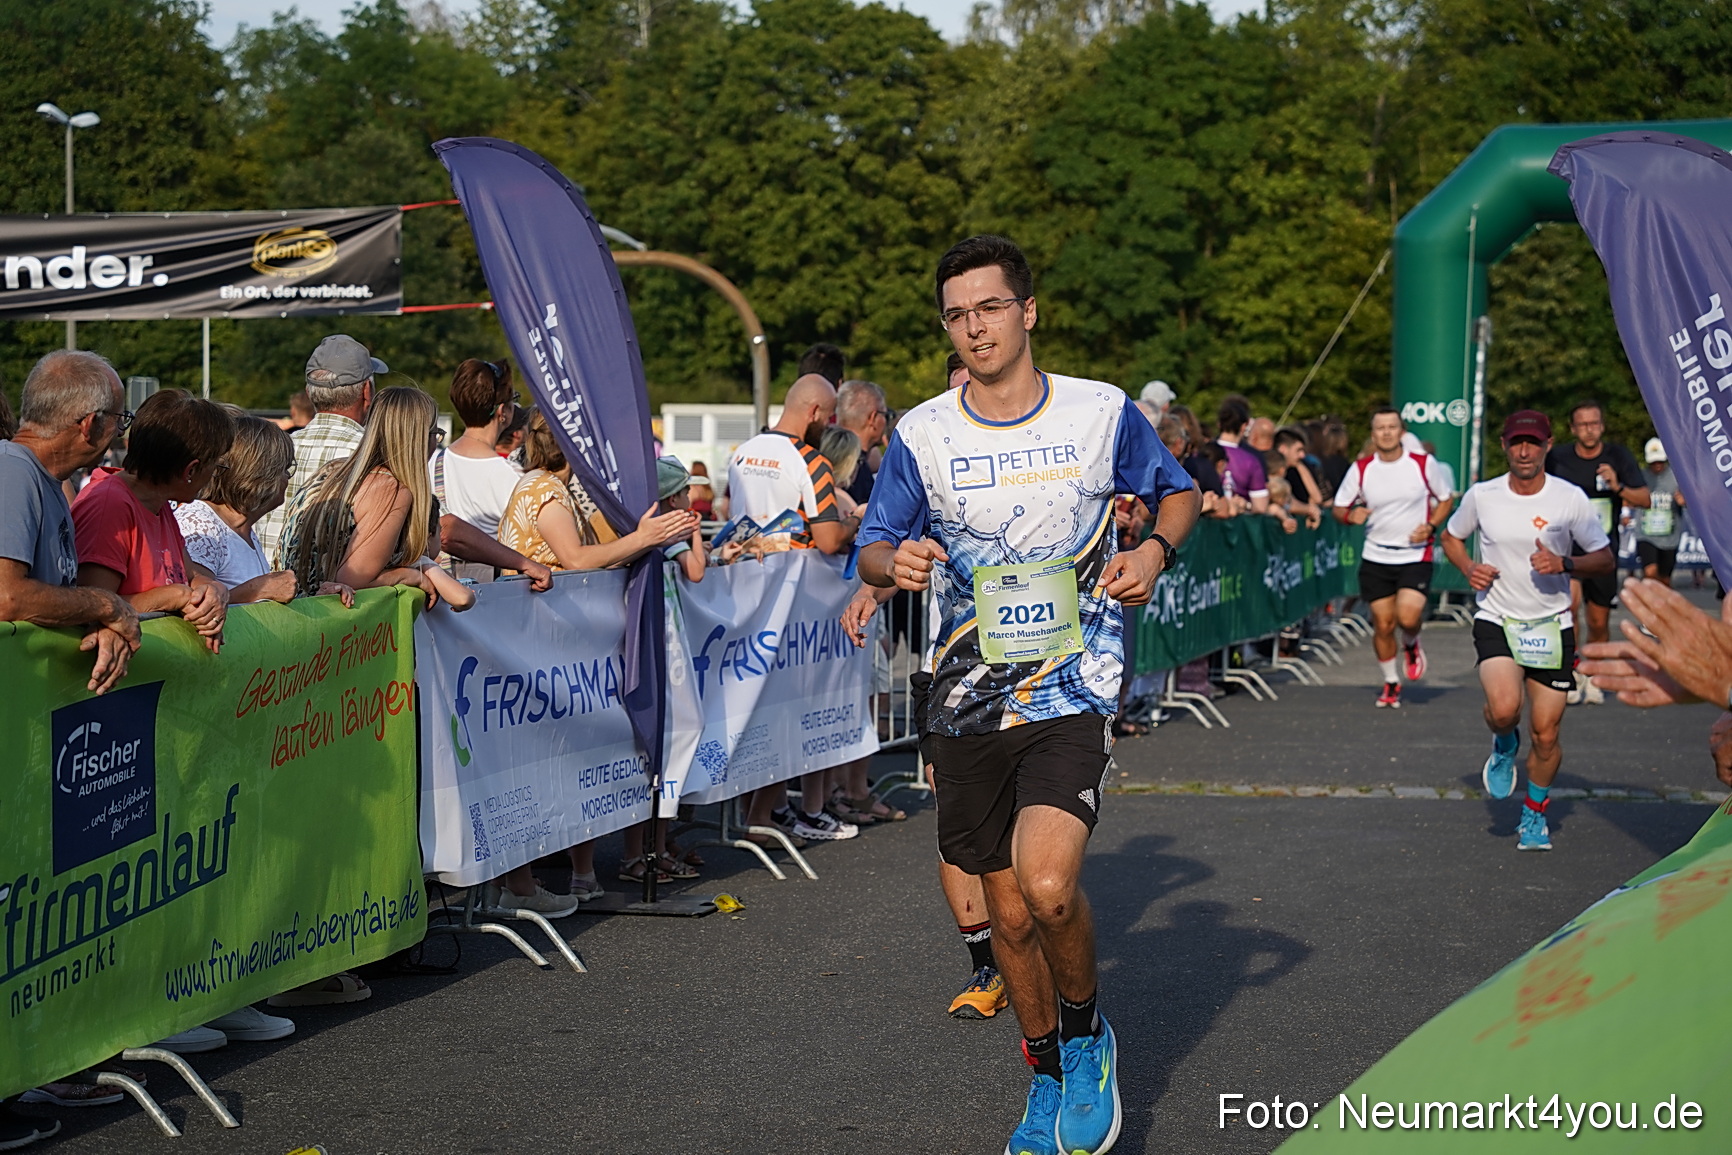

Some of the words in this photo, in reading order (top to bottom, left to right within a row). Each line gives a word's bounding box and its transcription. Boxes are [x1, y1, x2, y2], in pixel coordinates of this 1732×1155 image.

[220, 285, 243, 299] Ein
[244, 285, 271, 300] Ort,
[273, 285, 299, 298] der
[300, 283, 374, 299] verbindet.
[1401, 401, 1447, 424] AOK
[745, 457, 781, 470] KLEBL
[998, 444, 1080, 471] PETTER
[1000, 466, 1082, 487] INGENIEURE
[997, 602, 1055, 626] 2021
[987, 630, 1015, 640] Marco
[1017, 621, 1073, 639] Muschaweck
[235, 632, 333, 719] Gesunde
[336, 621, 398, 677] Firmen
[483, 654, 626, 733] FRISCHMA
[270, 698, 335, 770] laufen
[340, 678, 415, 742] länger
[801, 711, 822, 731] HEUTE
[71, 738, 141, 783] Fischer
[802, 736, 830, 758] MORGEN
[78, 765, 136, 798] AUTOMOBILE
[578, 763, 610, 790] HEUTE
[612, 755, 650, 782] GEDACH
[108, 799, 122, 816] das
[581, 791, 619, 822] MORGEN
[4, 782, 240, 975] firmenlauf
[165, 879, 420, 1003] www.firmenlauf-oberpfalz.de
[11, 935, 116, 1019] neumarkt
